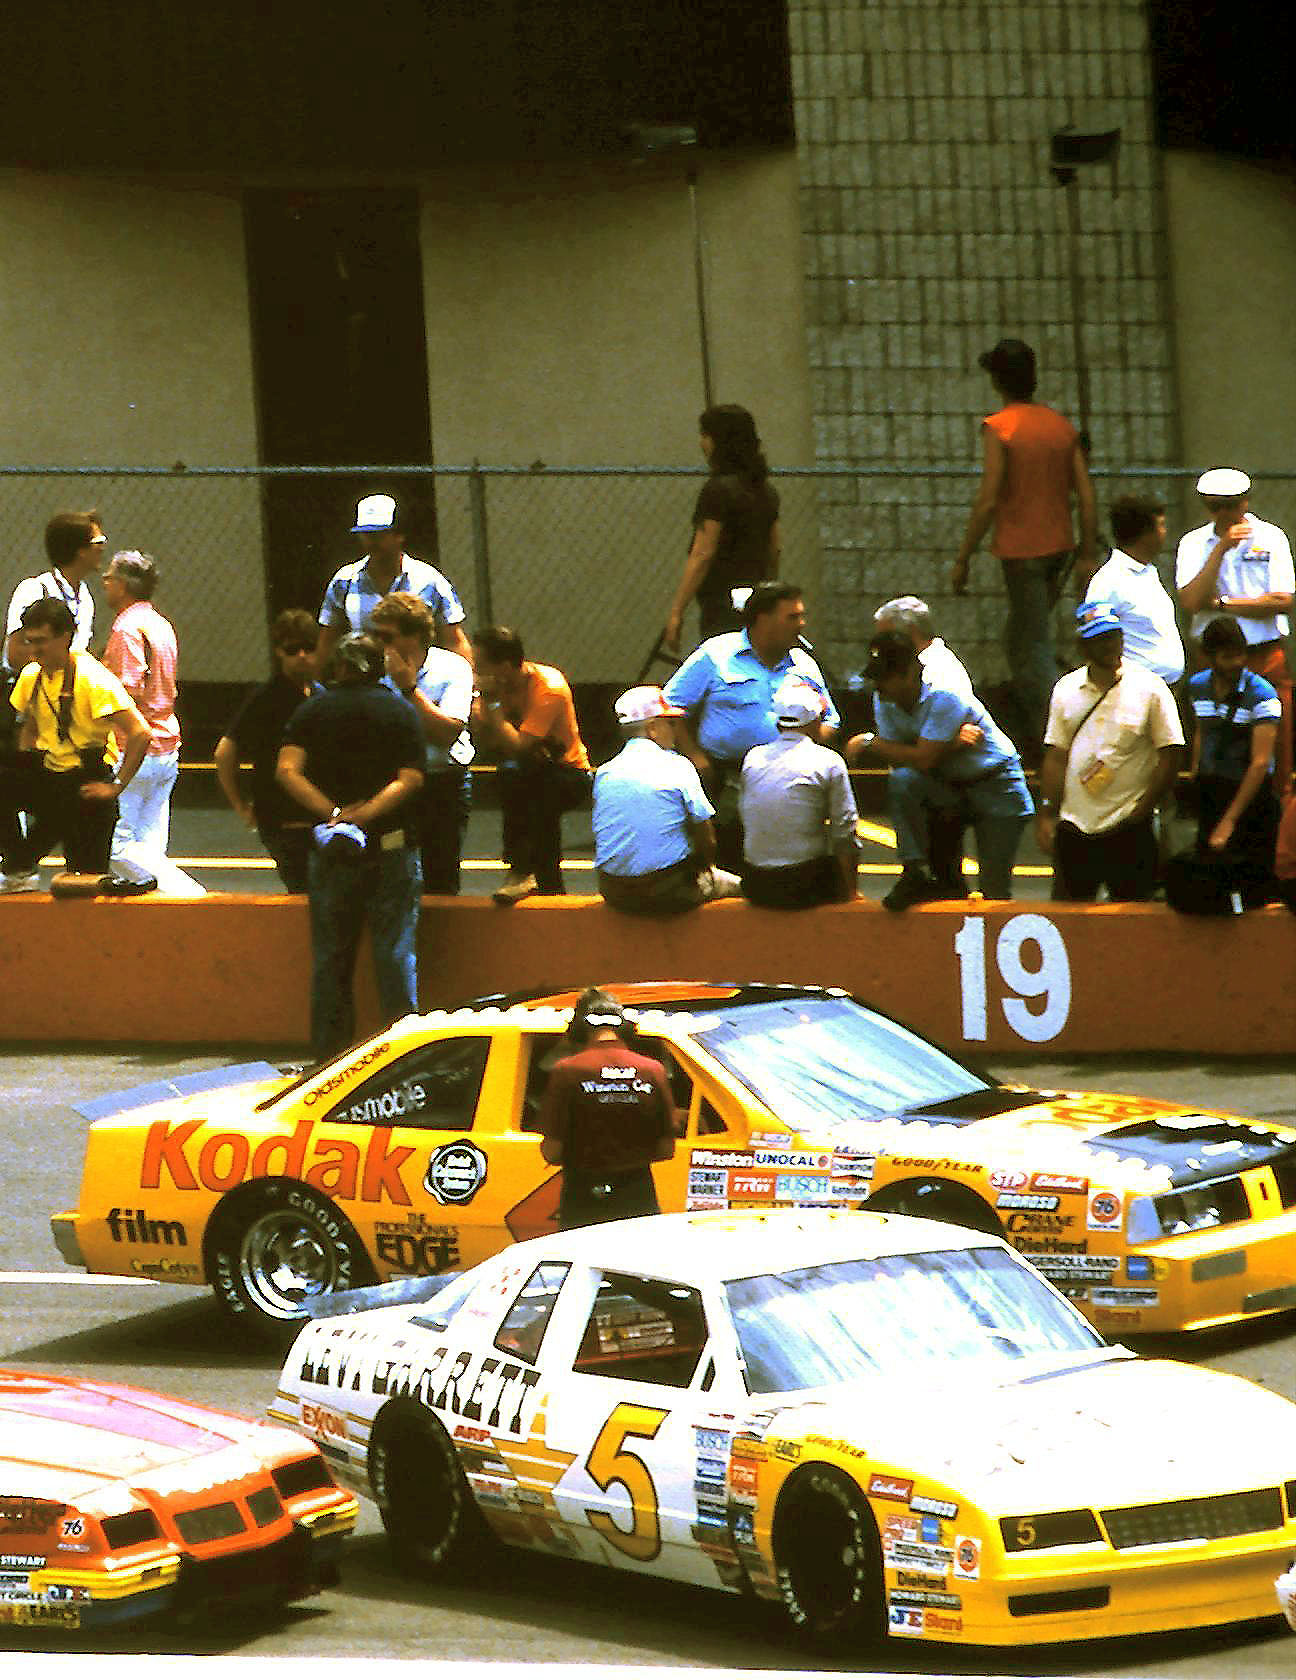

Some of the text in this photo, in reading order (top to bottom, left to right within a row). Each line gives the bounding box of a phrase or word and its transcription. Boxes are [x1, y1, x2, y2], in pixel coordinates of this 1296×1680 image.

[955, 913, 1071, 1043] 19
[140, 1119, 416, 1206] Kodak
[692, 1150, 753, 1167] Winston
[755, 1153, 815, 1166] UNOCAL
[106, 1208, 188, 1246] film
[377, 1235, 461, 1276] EDGE
[584, 1402, 672, 1562] 5
[64, 1519, 83, 1536] 76
[1015, 1517, 1037, 1548] 5
[0, 1555, 47, 1567] STEWART
